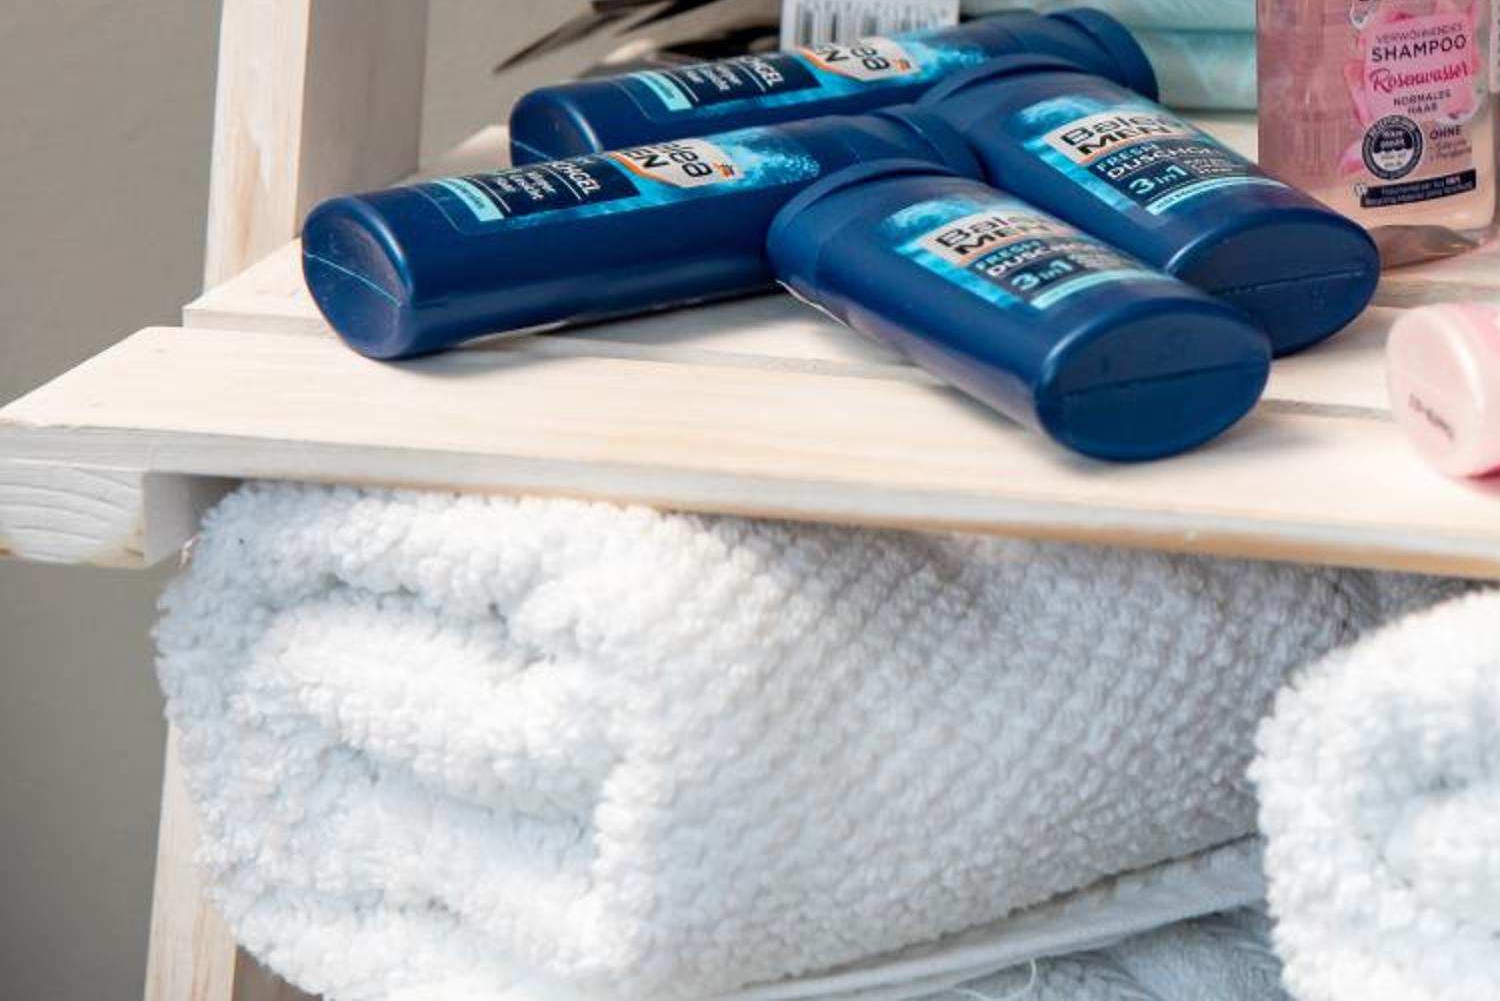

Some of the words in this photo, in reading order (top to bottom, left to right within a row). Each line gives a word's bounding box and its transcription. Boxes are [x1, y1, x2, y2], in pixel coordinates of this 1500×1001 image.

[1371, 33, 1468, 63] SHAMPOO
[1392, 88, 1452, 107] NORMALES
[1429, 124, 1463, 140] OHNE
[1096, 142, 1160, 172] FRESH
